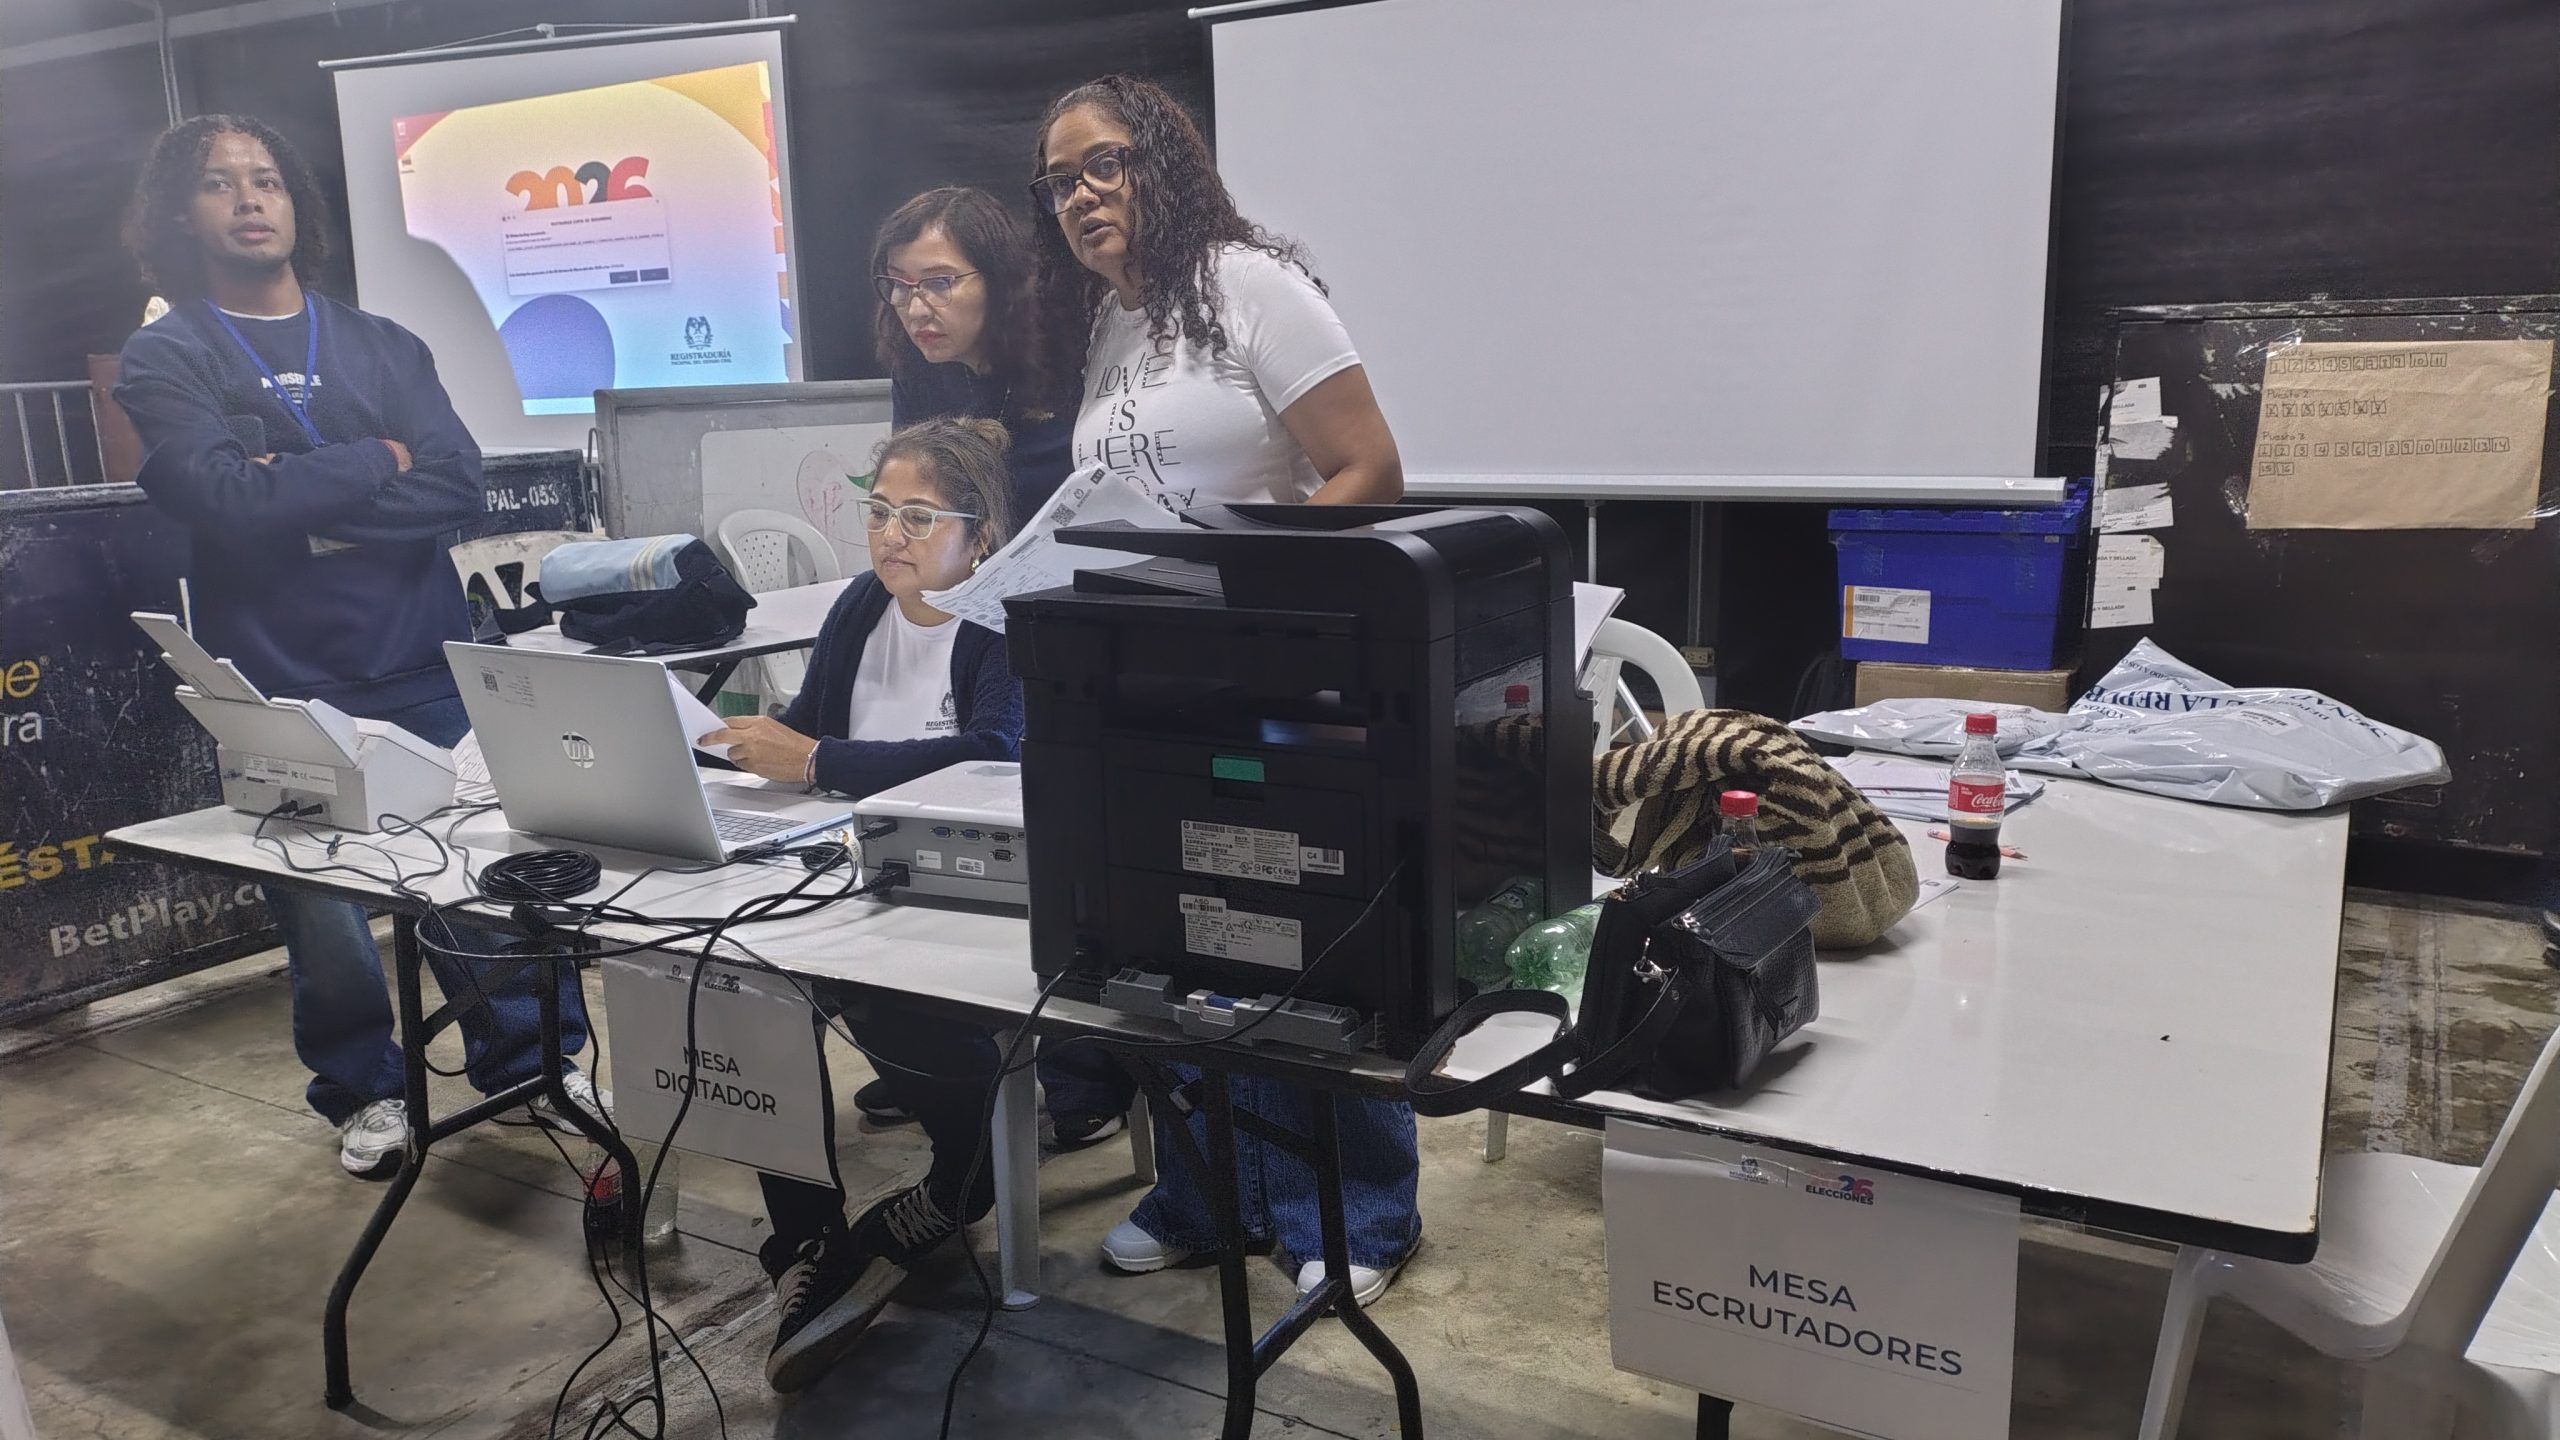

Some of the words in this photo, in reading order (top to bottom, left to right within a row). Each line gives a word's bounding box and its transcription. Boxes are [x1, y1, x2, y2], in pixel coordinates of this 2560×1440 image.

[1096, 351, 1172, 398] LOVE
[1108, 399, 1136, 433] IS
[2262, 431, 2296, 441] Puesto
[1078, 429, 1181, 485] HERE
[683, 1046, 741, 1077] MESA
[1805, 1184, 1874, 1206] ELECCIONES
[1749, 1264, 1857, 1312] MESA
[1653, 1280, 1963, 1376] ESCRUTADORES
